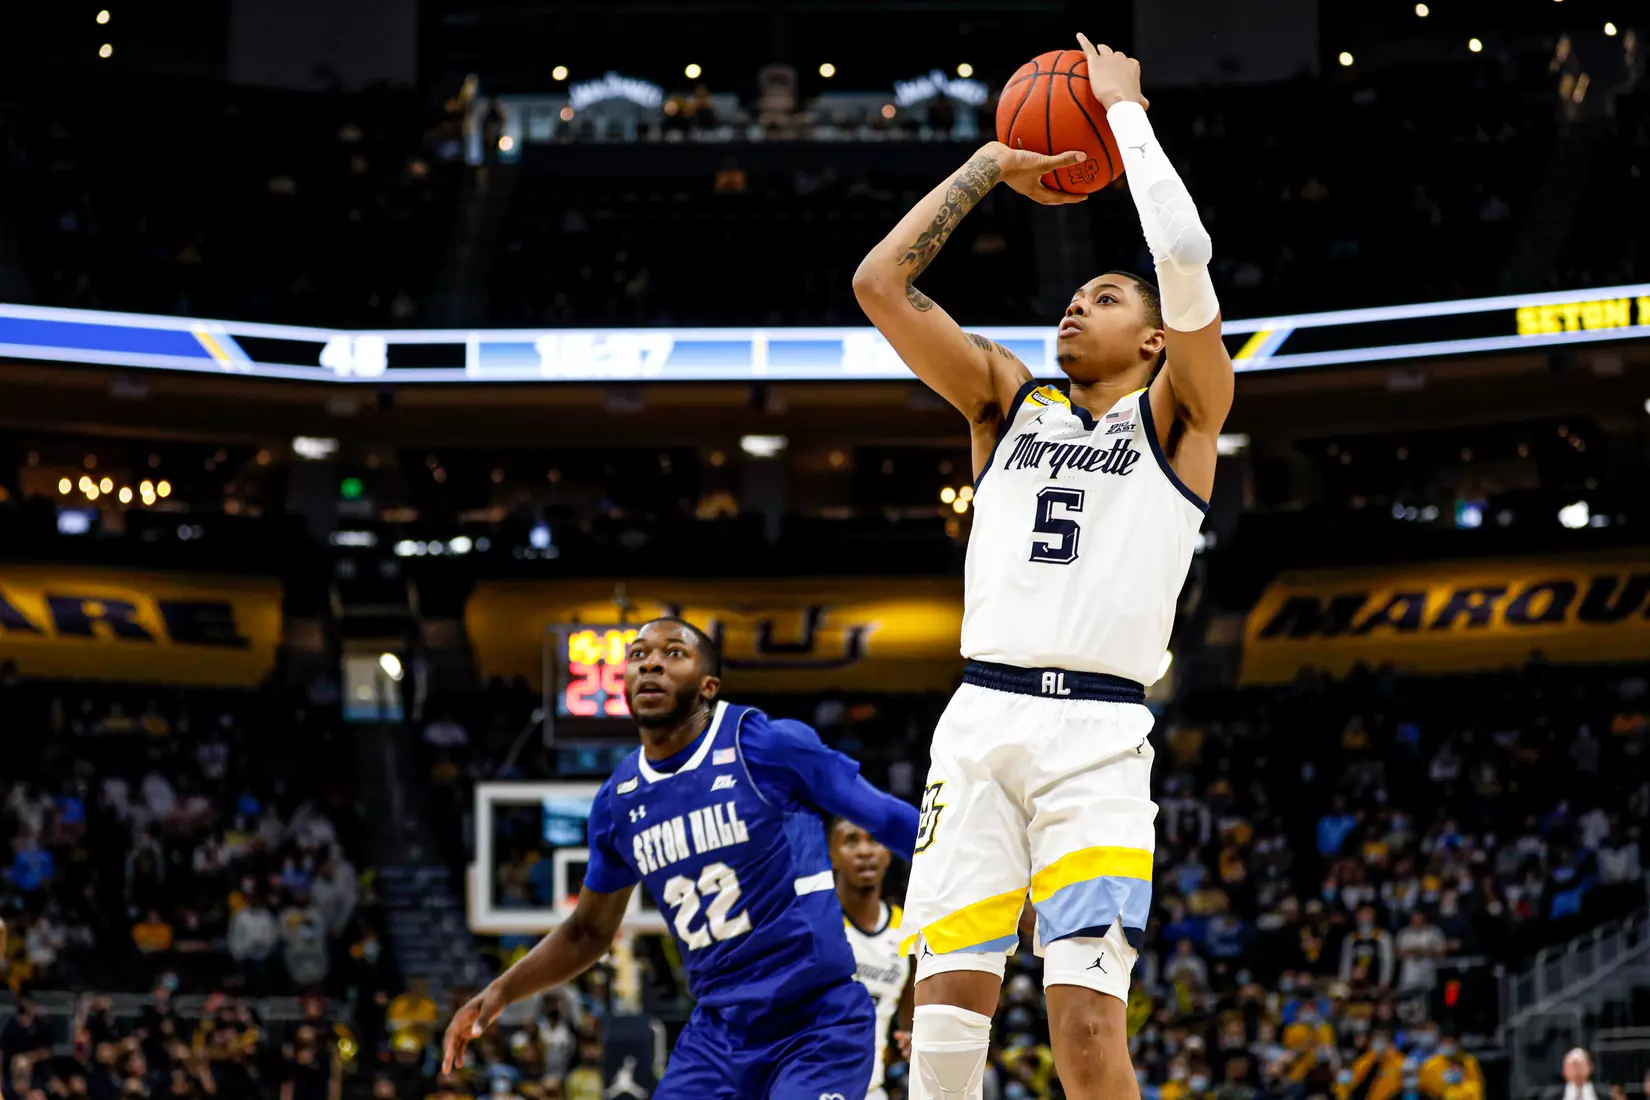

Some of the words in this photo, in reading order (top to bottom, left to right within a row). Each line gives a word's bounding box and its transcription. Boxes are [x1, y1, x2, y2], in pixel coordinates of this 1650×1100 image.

[1516, 298, 1631, 335] SETON
[1003, 432, 1142, 479] Marquette
[1106, 424, 1136, 435] EAST
[1028, 486, 1086, 566] 5
[1257, 573, 1650, 638] MARQU
[566, 661, 630, 716] 25
[1041, 671, 1071, 696] AL
[632, 815, 691, 876] SETON
[688, 801, 750, 855] HALL
[663, 861, 753, 951] 22
